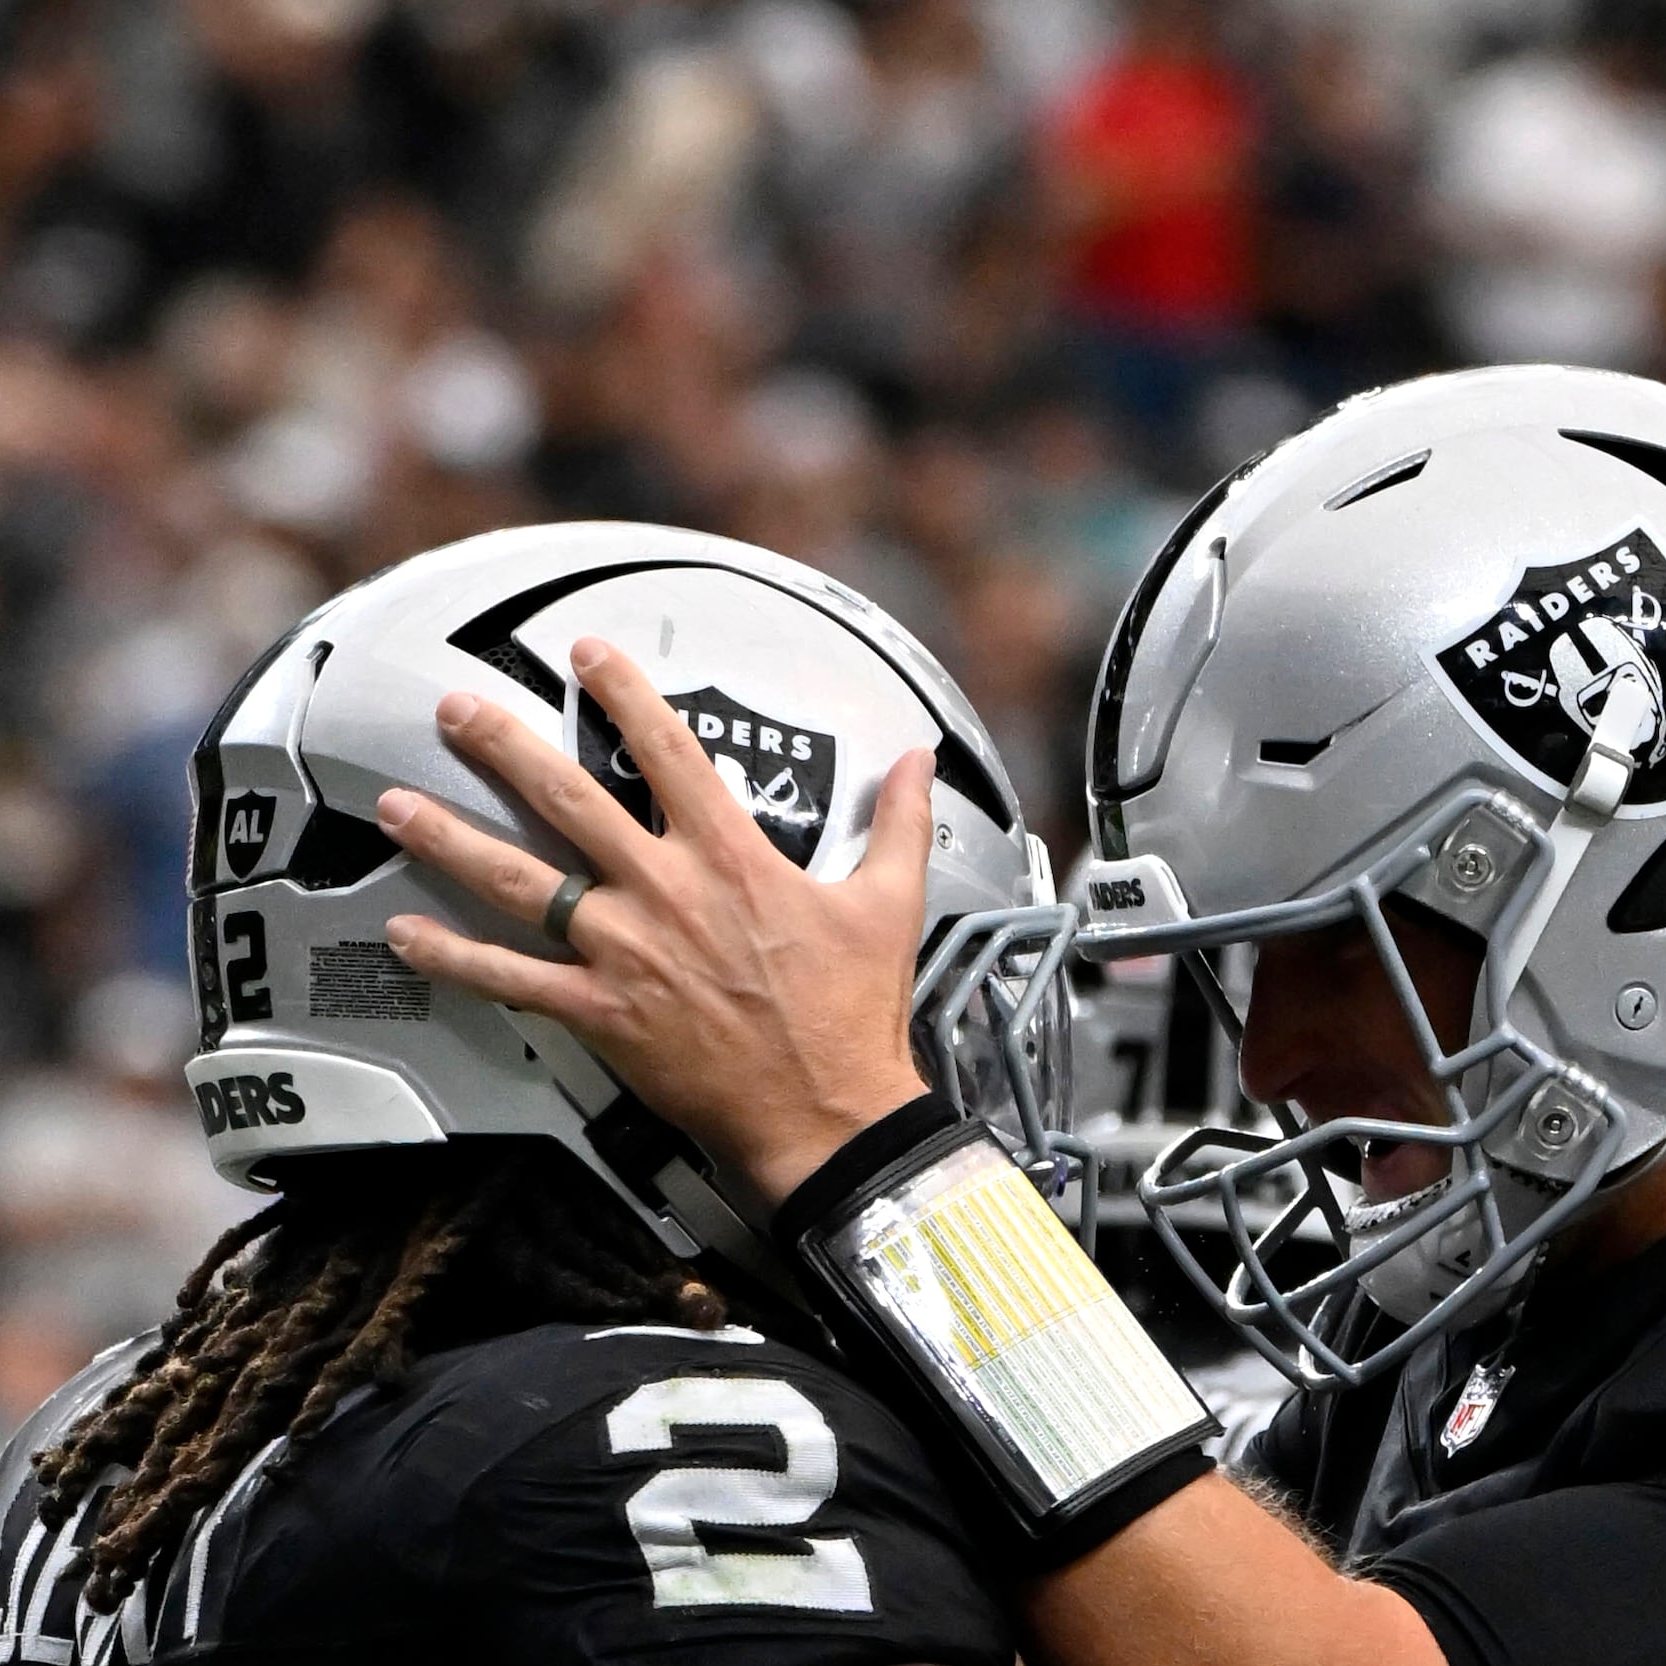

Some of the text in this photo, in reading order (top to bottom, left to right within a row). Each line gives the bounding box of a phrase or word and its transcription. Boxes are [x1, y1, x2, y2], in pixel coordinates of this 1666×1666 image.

[1465, 546, 1641, 669] RAIDERS
[228, 808, 265, 845] AL
[223, 910, 273, 1022] 2
[605, 1374, 874, 1614] 2
